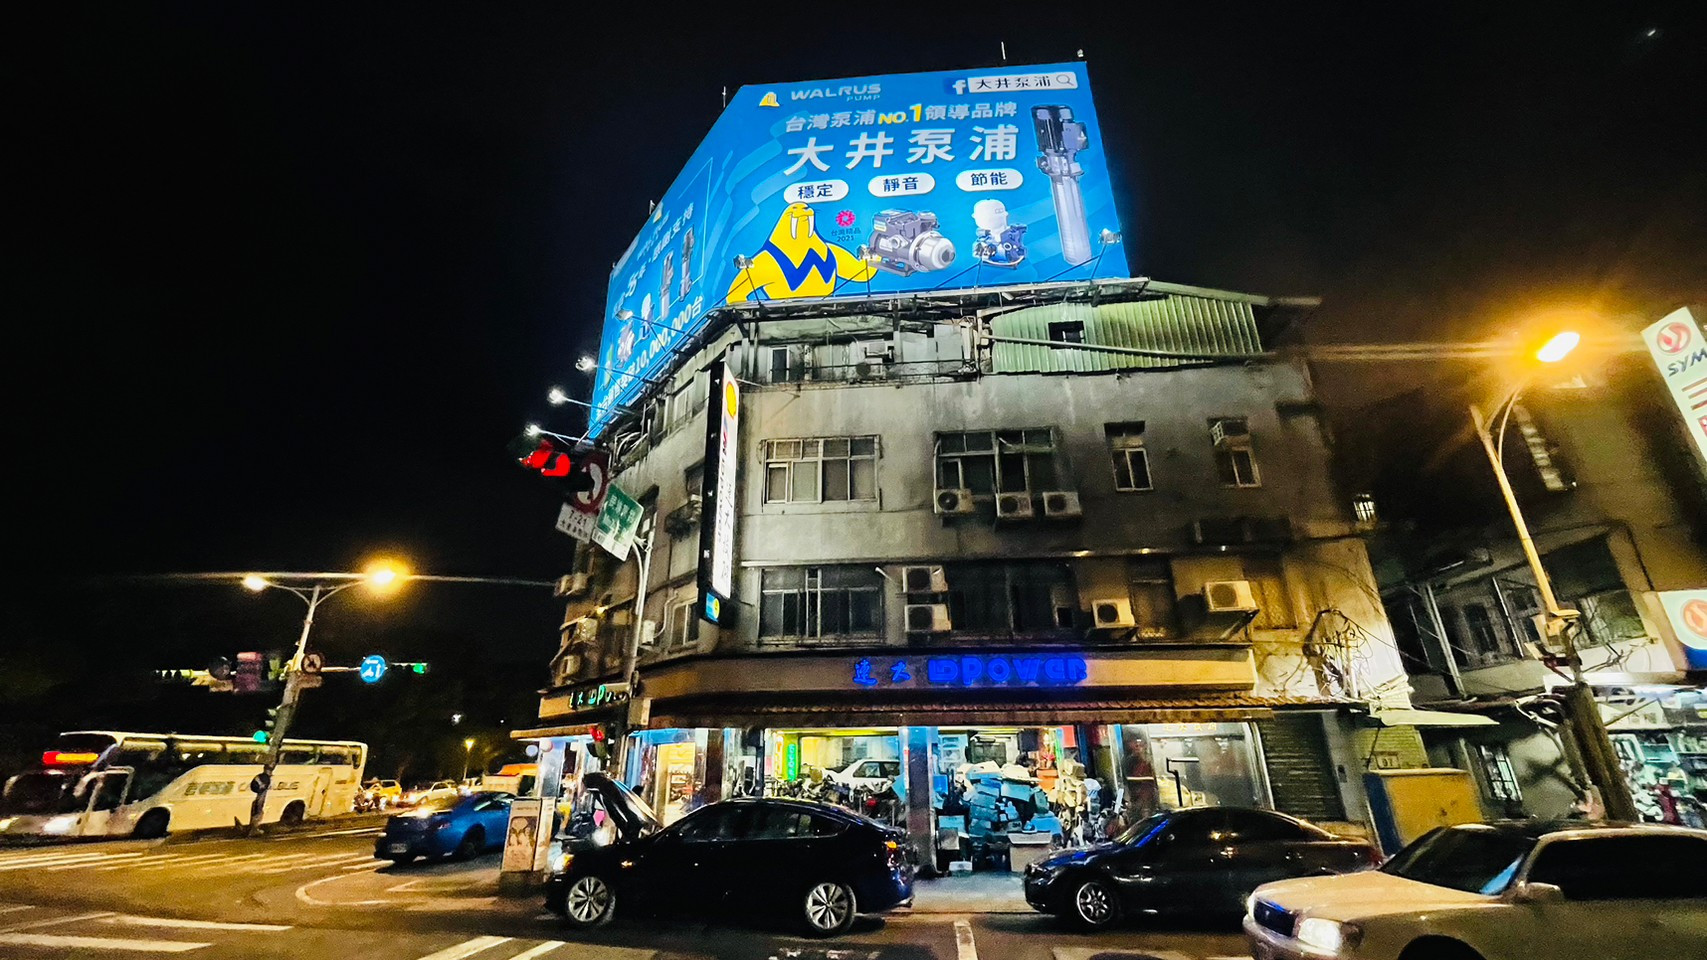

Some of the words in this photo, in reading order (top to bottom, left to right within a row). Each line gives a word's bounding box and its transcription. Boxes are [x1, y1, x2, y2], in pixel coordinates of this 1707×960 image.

[975, 75, 1051, 90] 大井泵浦
[790, 83, 882, 101] WALRUS
[846, 94, 881, 102] PUMP
[783, 124, 1020, 176] 大井泵浦
[883, 176, 920, 193] 靜音
[970, 171, 1009, 187] 節能
[797, 183, 834, 200] 穩定
